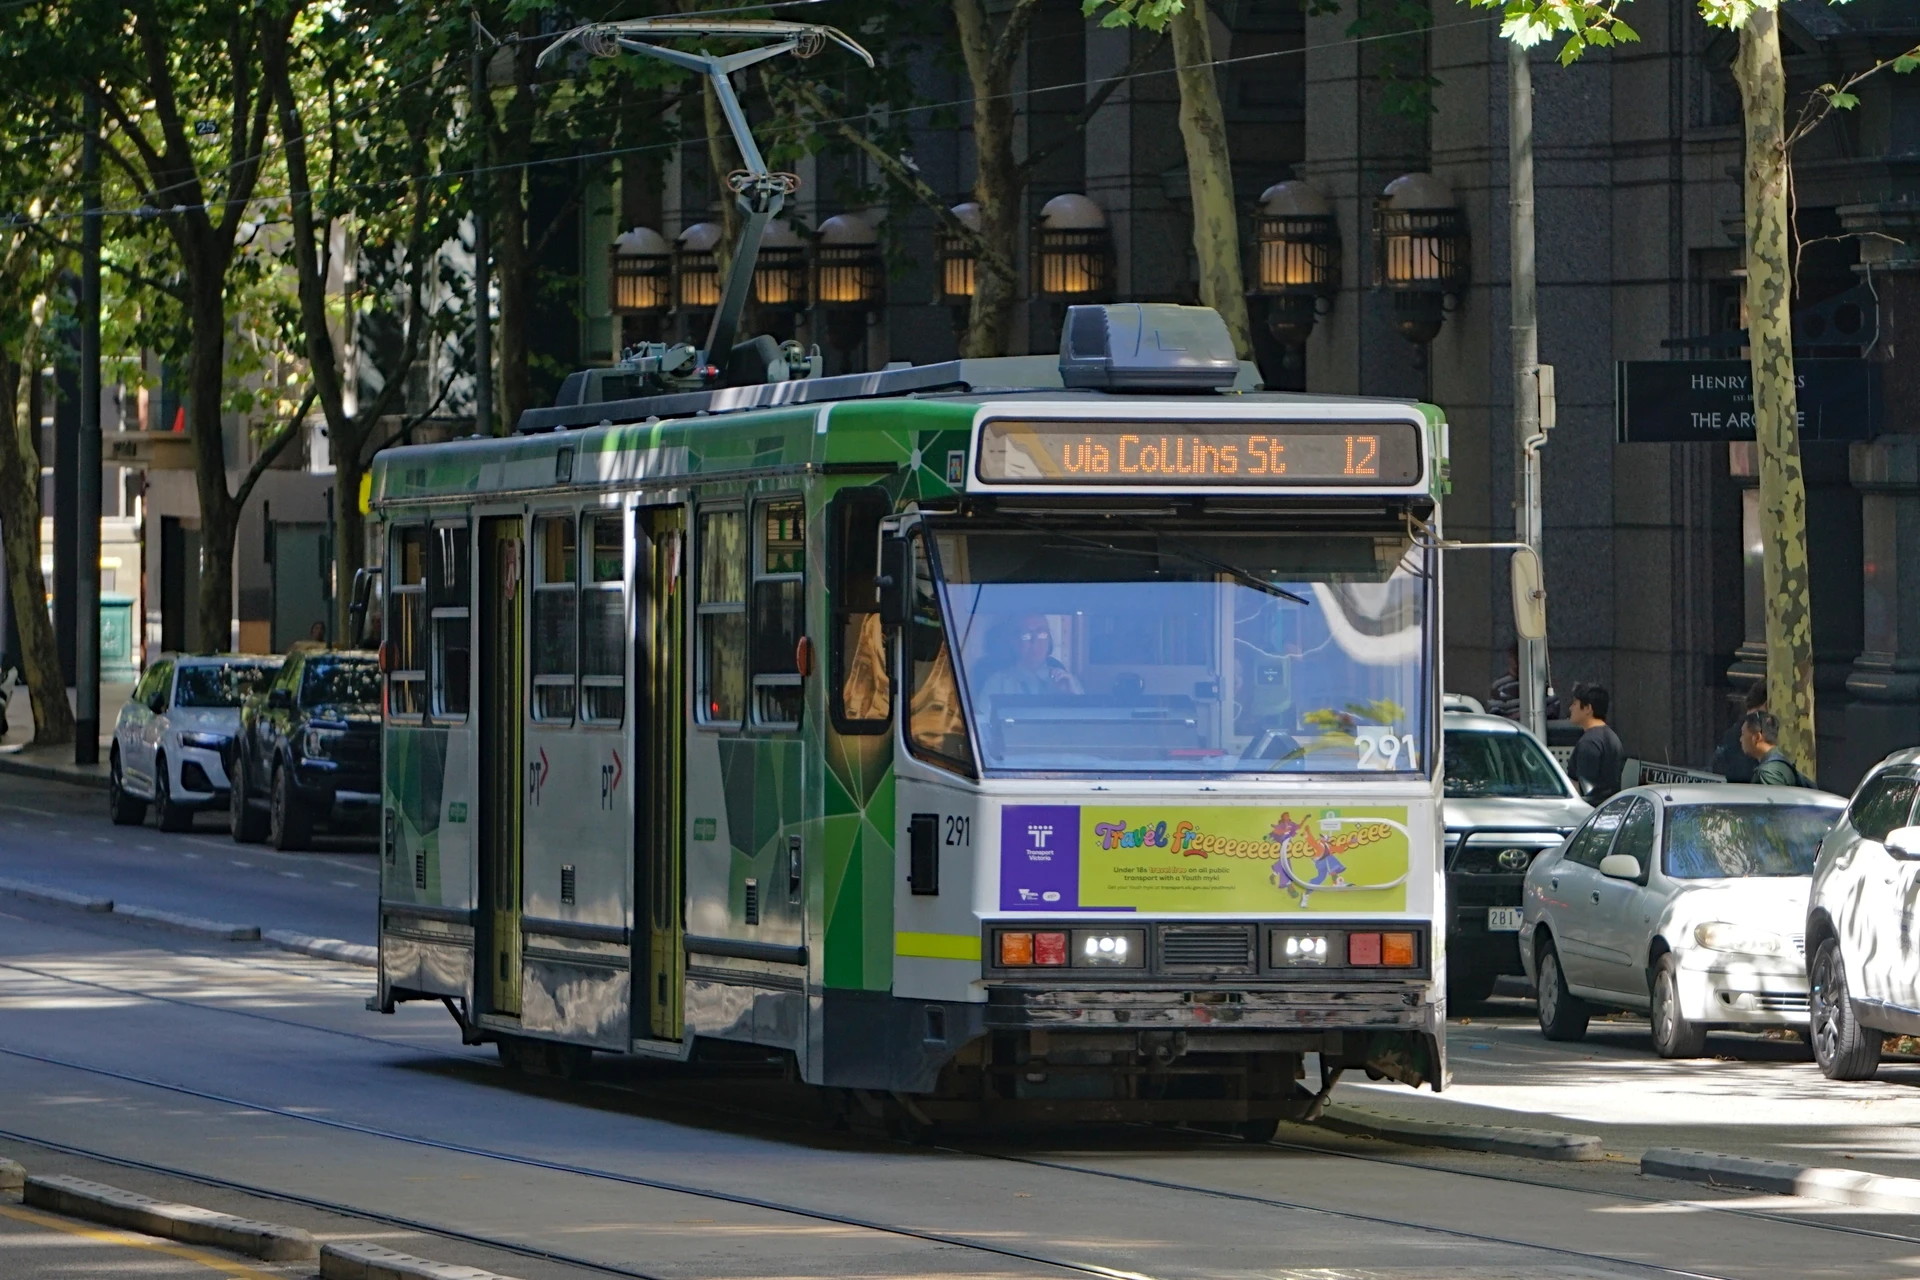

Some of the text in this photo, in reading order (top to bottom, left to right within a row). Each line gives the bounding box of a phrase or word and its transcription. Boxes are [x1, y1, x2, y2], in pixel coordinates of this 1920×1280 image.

[196, 120, 217, 134] 25
[1691, 374, 1747, 389] HENRY
[1691, 412, 1721, 428] THE
[1063, 435, 1376, 475] via Collins St 12
[1354, 734, 1417, 770] 291
[945, 814, 970, 847] 291
[1095, 820, 1168, 850] Travel
[1203, 874, 1220, 882] myki
[1209, 866, 1230, 875] public
